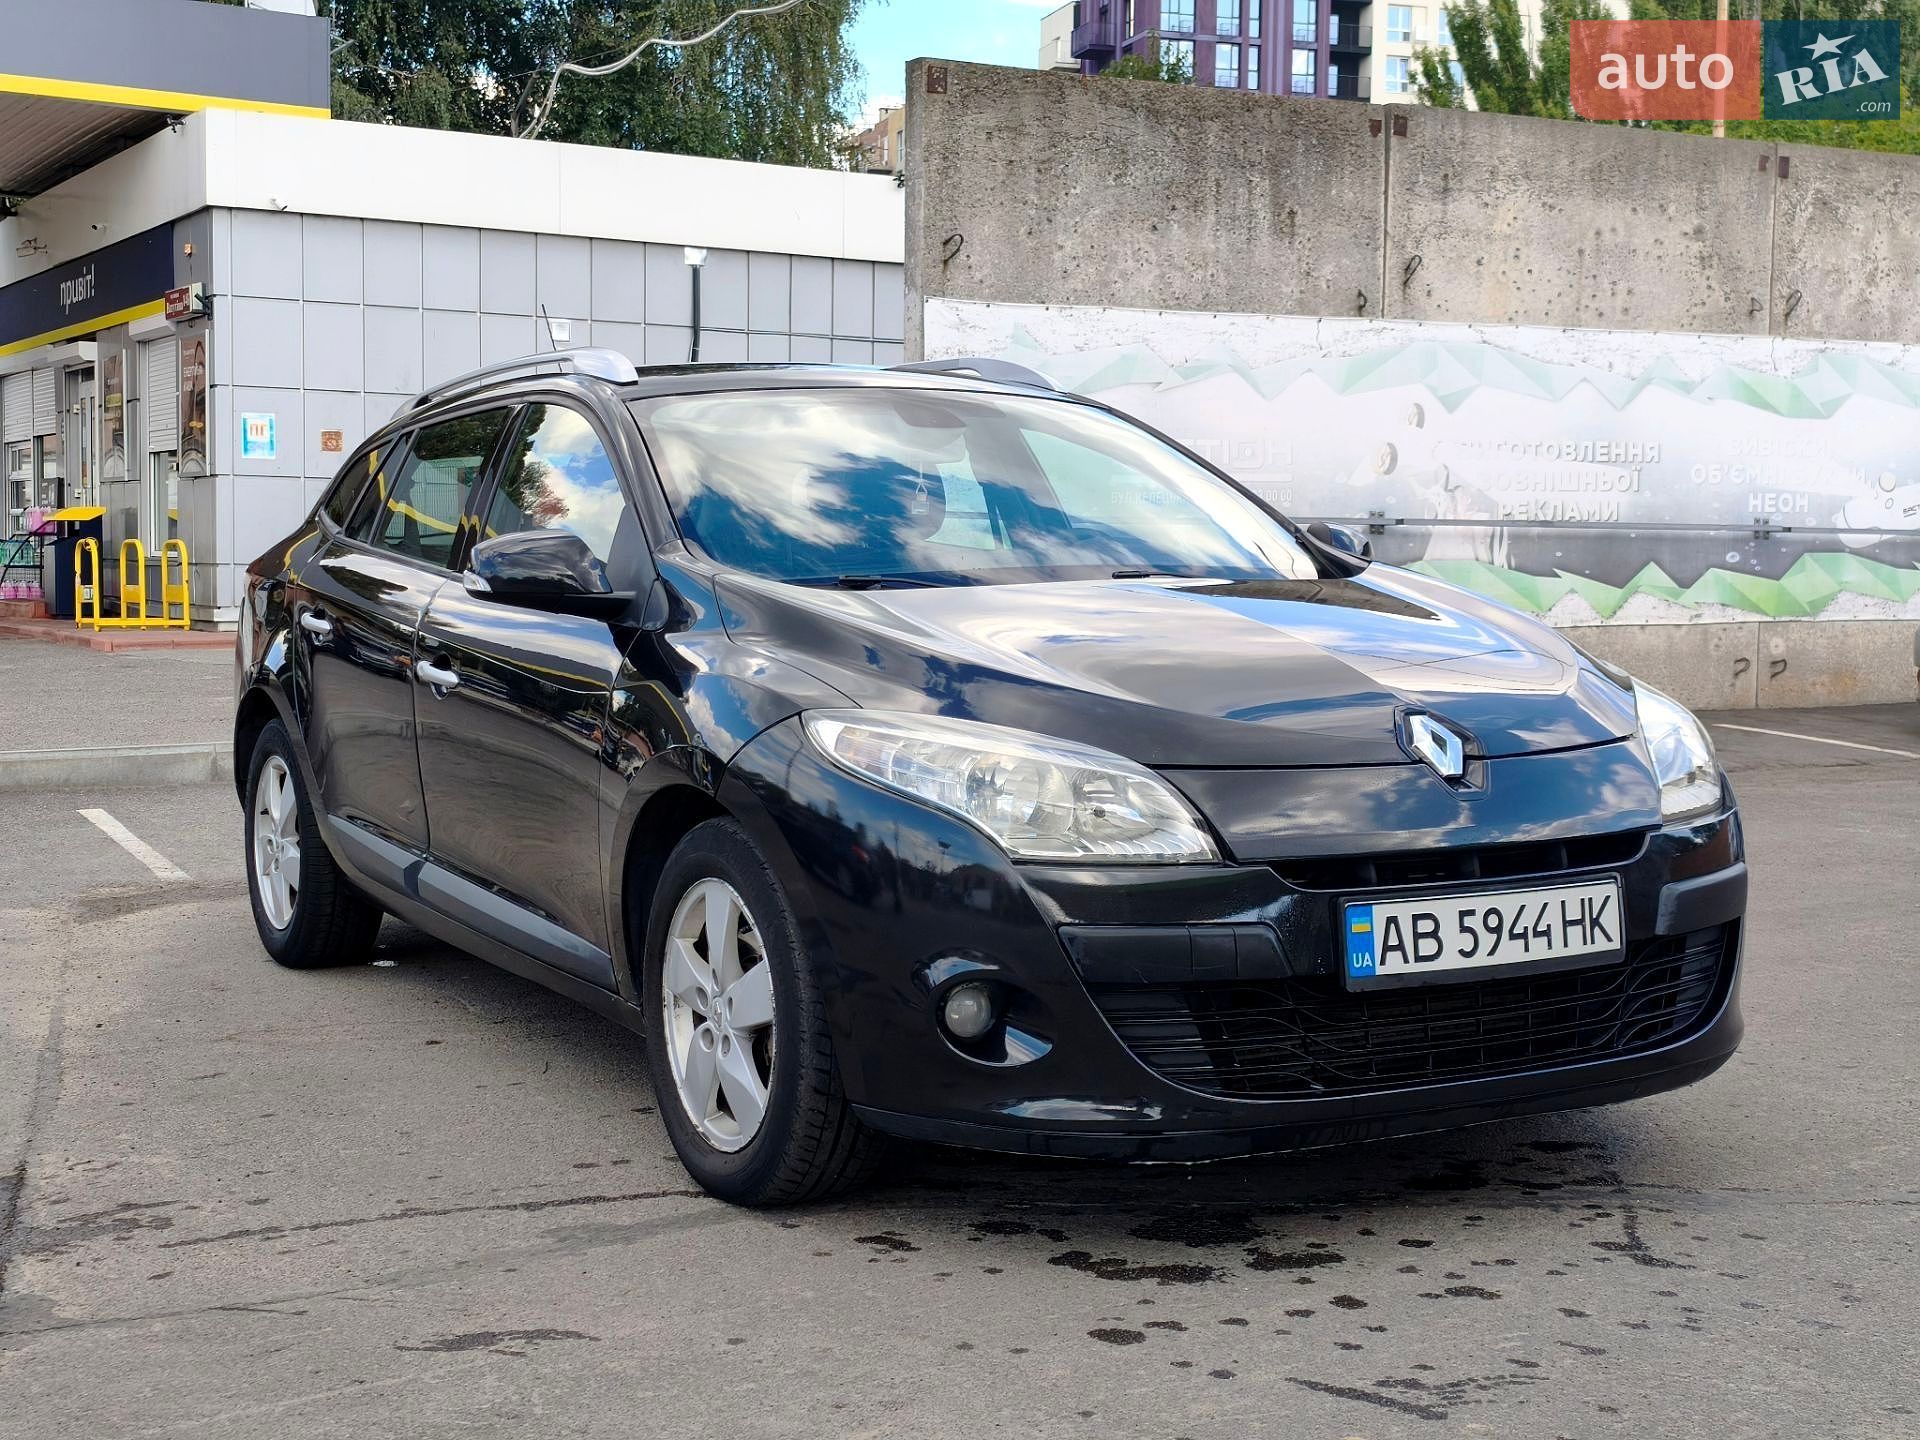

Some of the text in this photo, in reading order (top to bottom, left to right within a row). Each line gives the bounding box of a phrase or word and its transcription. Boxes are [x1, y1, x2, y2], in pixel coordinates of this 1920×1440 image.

[60, 263, 95, 315] привіт!
[1497, 500, 1620, 521] РЕКЛАМИ
[1749, 493, 1809, 513] НЕОН
[1353, 894, 1615, 969] UA AB 5944 HK
